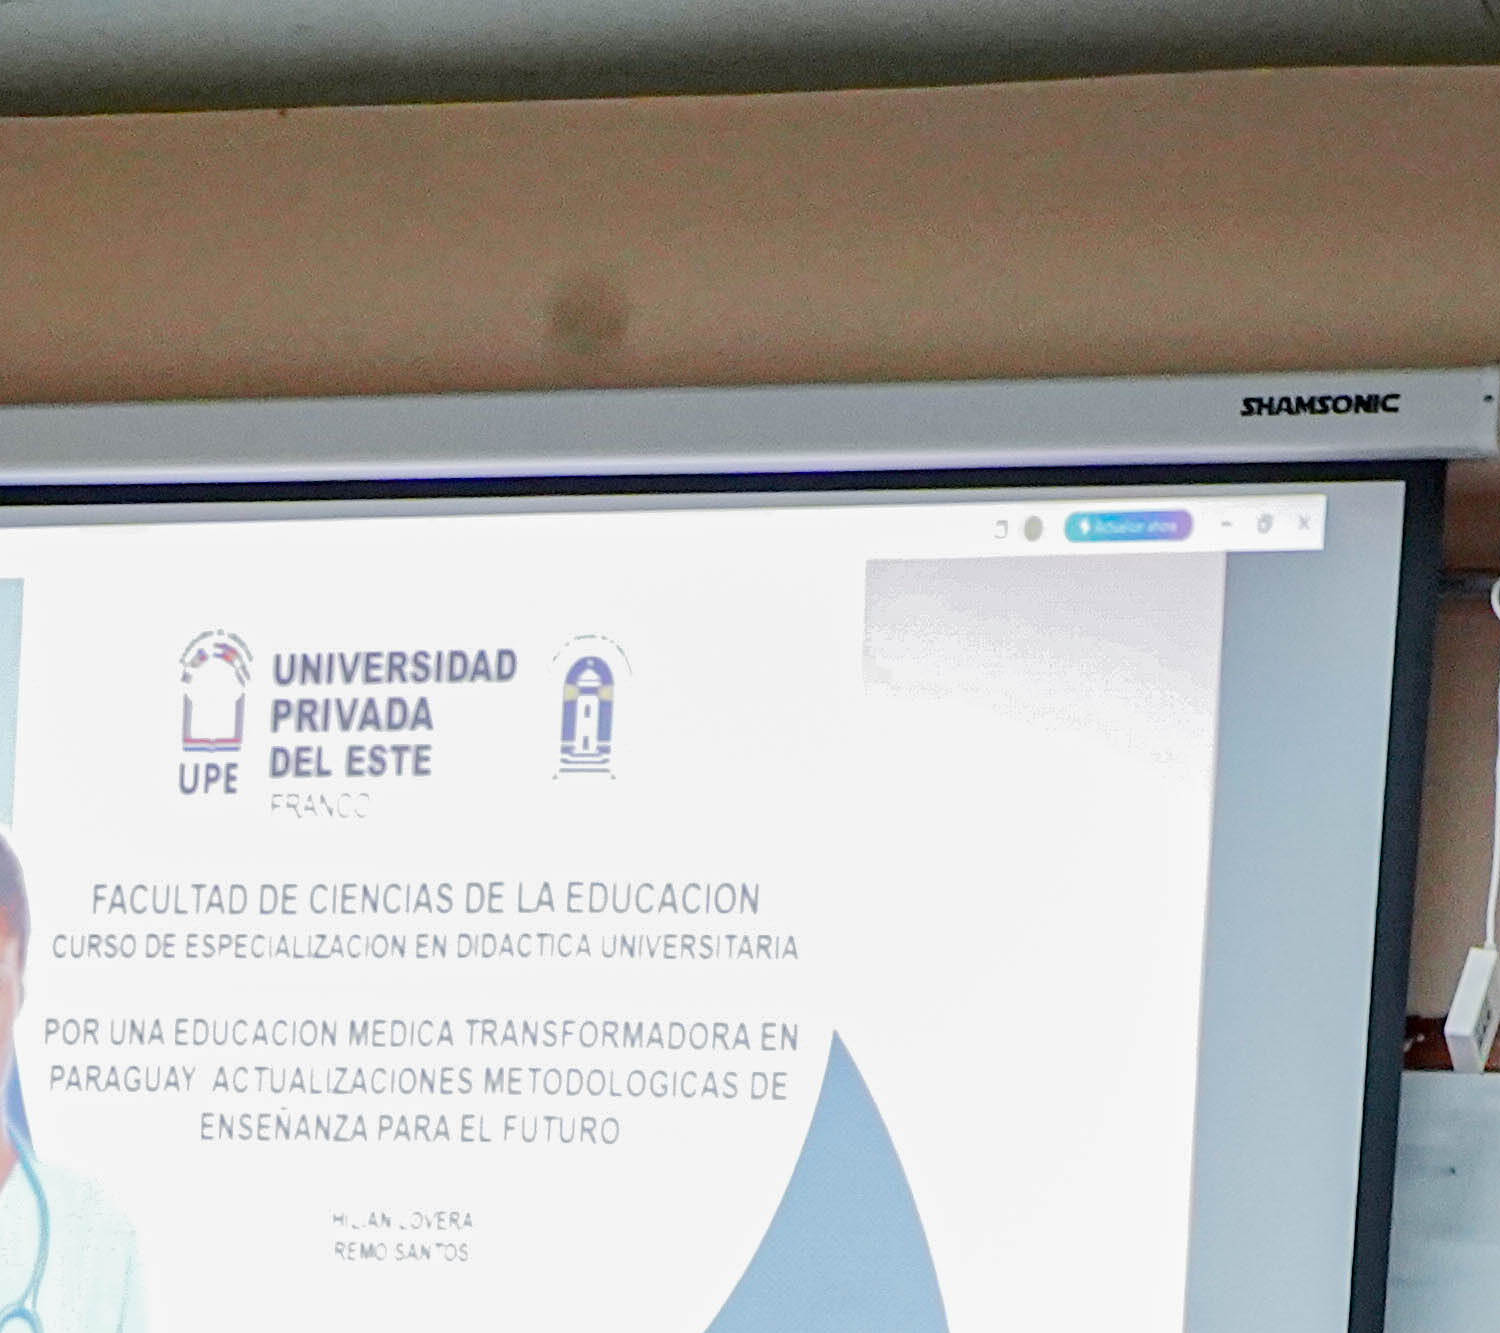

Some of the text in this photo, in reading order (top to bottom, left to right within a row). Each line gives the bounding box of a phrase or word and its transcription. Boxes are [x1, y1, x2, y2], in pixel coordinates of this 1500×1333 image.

[1240, 393, 1400, 417] SHAMSONIC
[273, 648, 518, 687] UNIVERSIDAD
[269, 696, 434, 732] PRIVADA
[179, 762, 239, 794] UPE
[268, 744, 432, 779] DEL ESTE
[92, 881, 760, 915] FACULTAD DE CIENCIAS DE LA EDUCACION
[52, 933, 799, 960] CURSO DE ESPECIALIZACION EN DIDACTICA UNIVERSITARIA
[45, 1018, 798, 1051] POR UNA EDUCACION MEDICA TRANSFORMADORA EN
[49, 1065, 787, 1100] PARAGUAY ACTUALIZACIONES METODOLOGICAS DE
[200, 1107, 620, 1144] ENSEÑANZA PARA EL FUTURO
[334, 1241, 388, 1262] REMO
